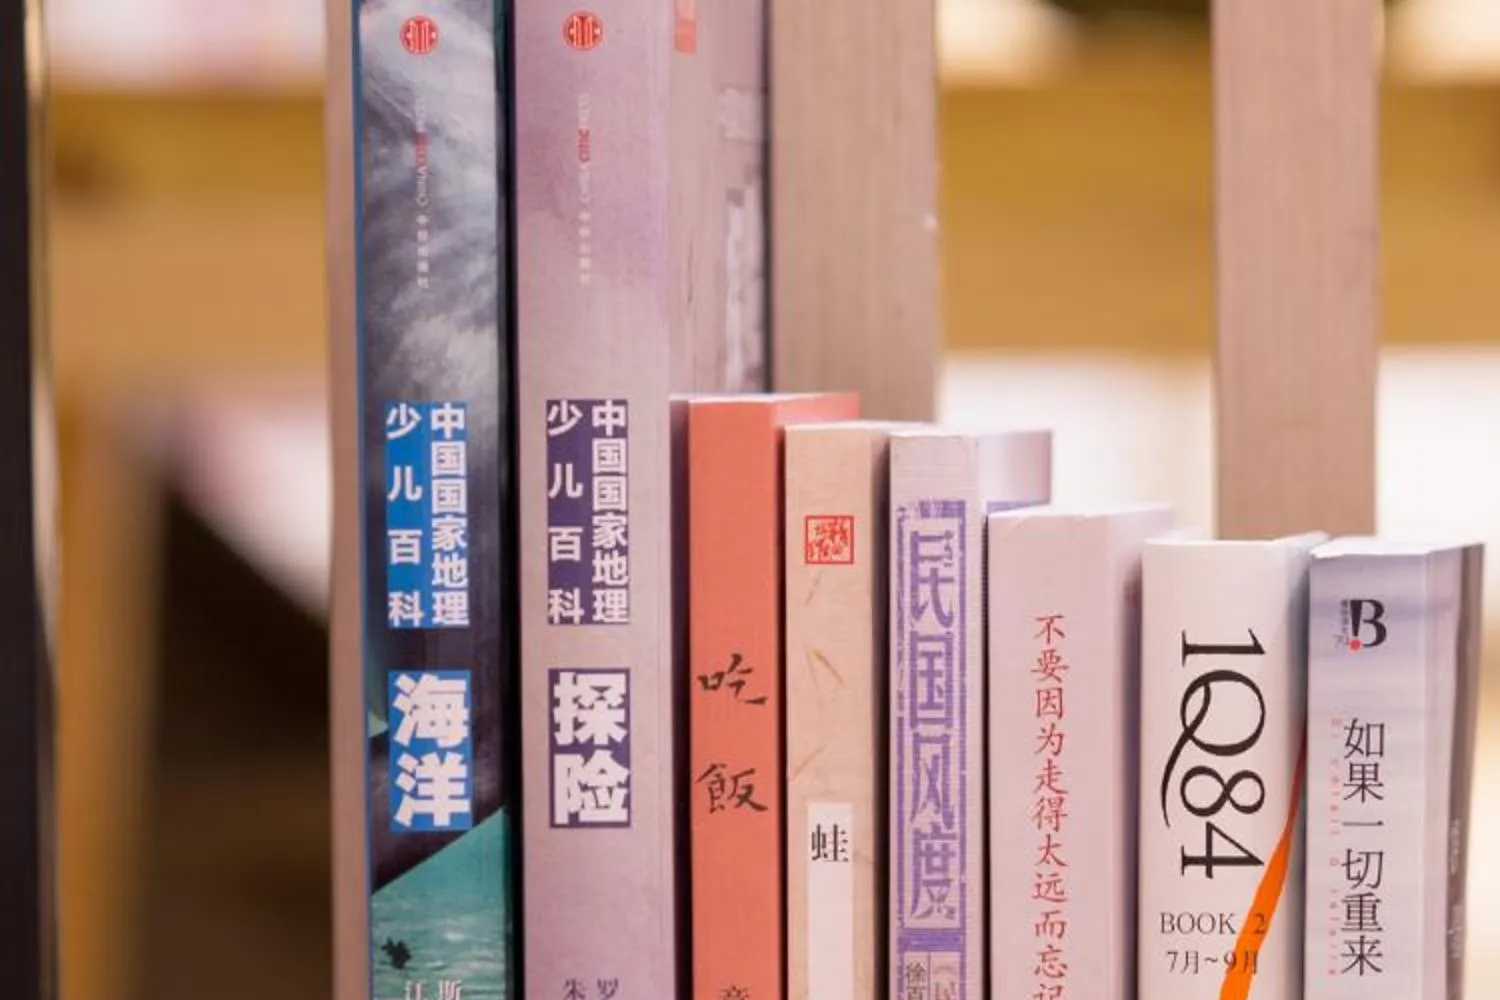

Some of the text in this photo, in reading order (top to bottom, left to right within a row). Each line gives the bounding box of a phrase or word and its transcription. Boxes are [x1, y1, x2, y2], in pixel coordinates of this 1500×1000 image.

[386, 403, 423, 628] 少儿百科
[431, 402, 470, 627] 中国国家地理
[547, 401, 584, 625] 少儿百科
[591, 400, 630, 625] 中国国家地理
[393, 674, 472, 828] 海洋
[553, 671, 630, 825] 探险
[908, 529, 958, 922] 民国风度
[1161, 627, 1266, 880] 1Q84
[811, 823, 849, 863] 蛙
[1158, 911, 1266, 936] BOOK 2
[1340, 716, 1386, 978] 如果一切重来
